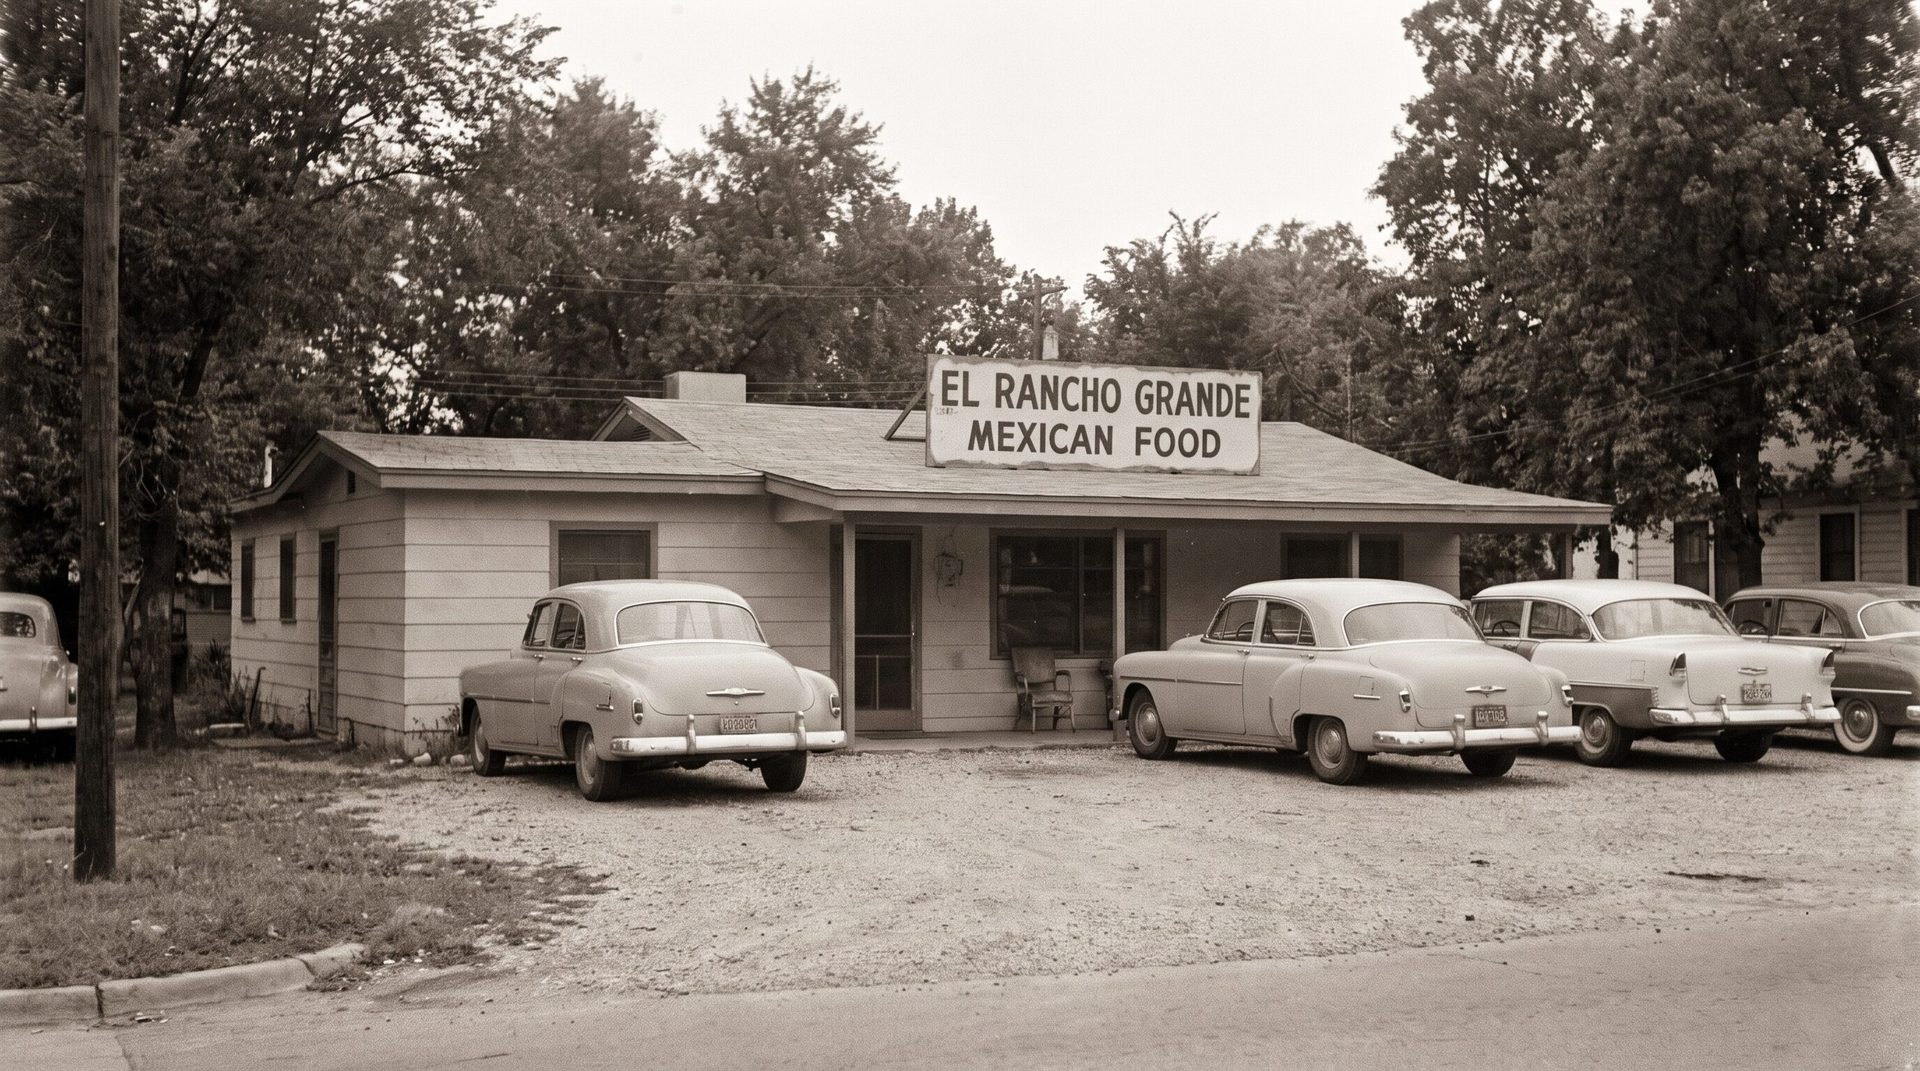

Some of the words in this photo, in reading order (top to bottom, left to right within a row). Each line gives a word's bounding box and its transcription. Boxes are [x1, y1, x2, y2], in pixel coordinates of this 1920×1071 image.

[942, 370, 980, 407] EL
[996, 373, 1121, 414] RANCHO
[1135, 380, 1251, 419] GRANDE
[968, 420, 1113, 456] MEXICAN
[1135, 427, 1221, 459] FOOD
